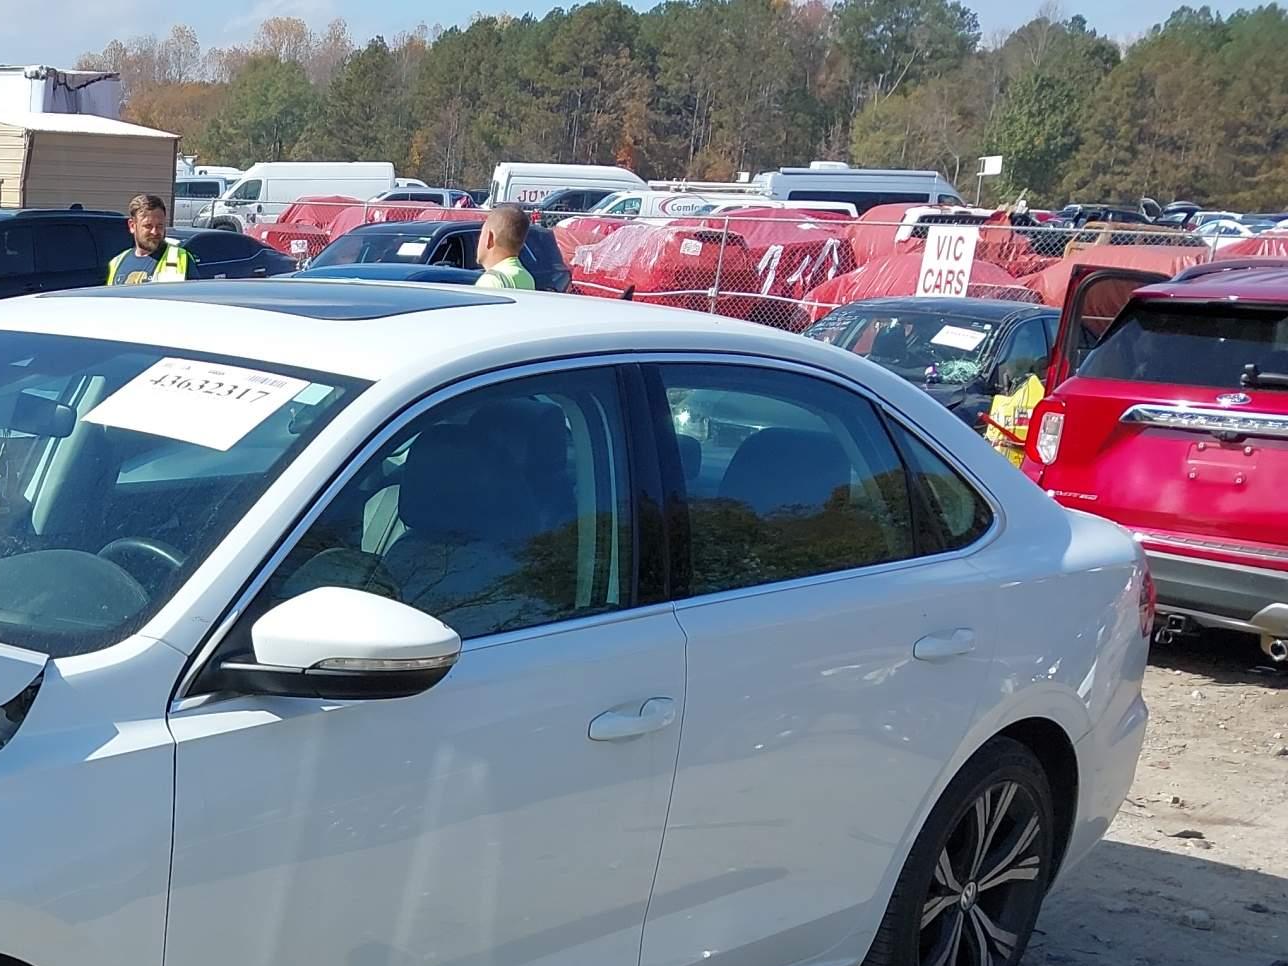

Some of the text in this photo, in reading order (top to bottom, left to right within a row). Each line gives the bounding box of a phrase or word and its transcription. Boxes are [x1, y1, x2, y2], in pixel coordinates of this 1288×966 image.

[937, 235, 965, 261] VIC
[922, 268, 966, 295] CARS
[149, 374, 272, 403] 43632317
